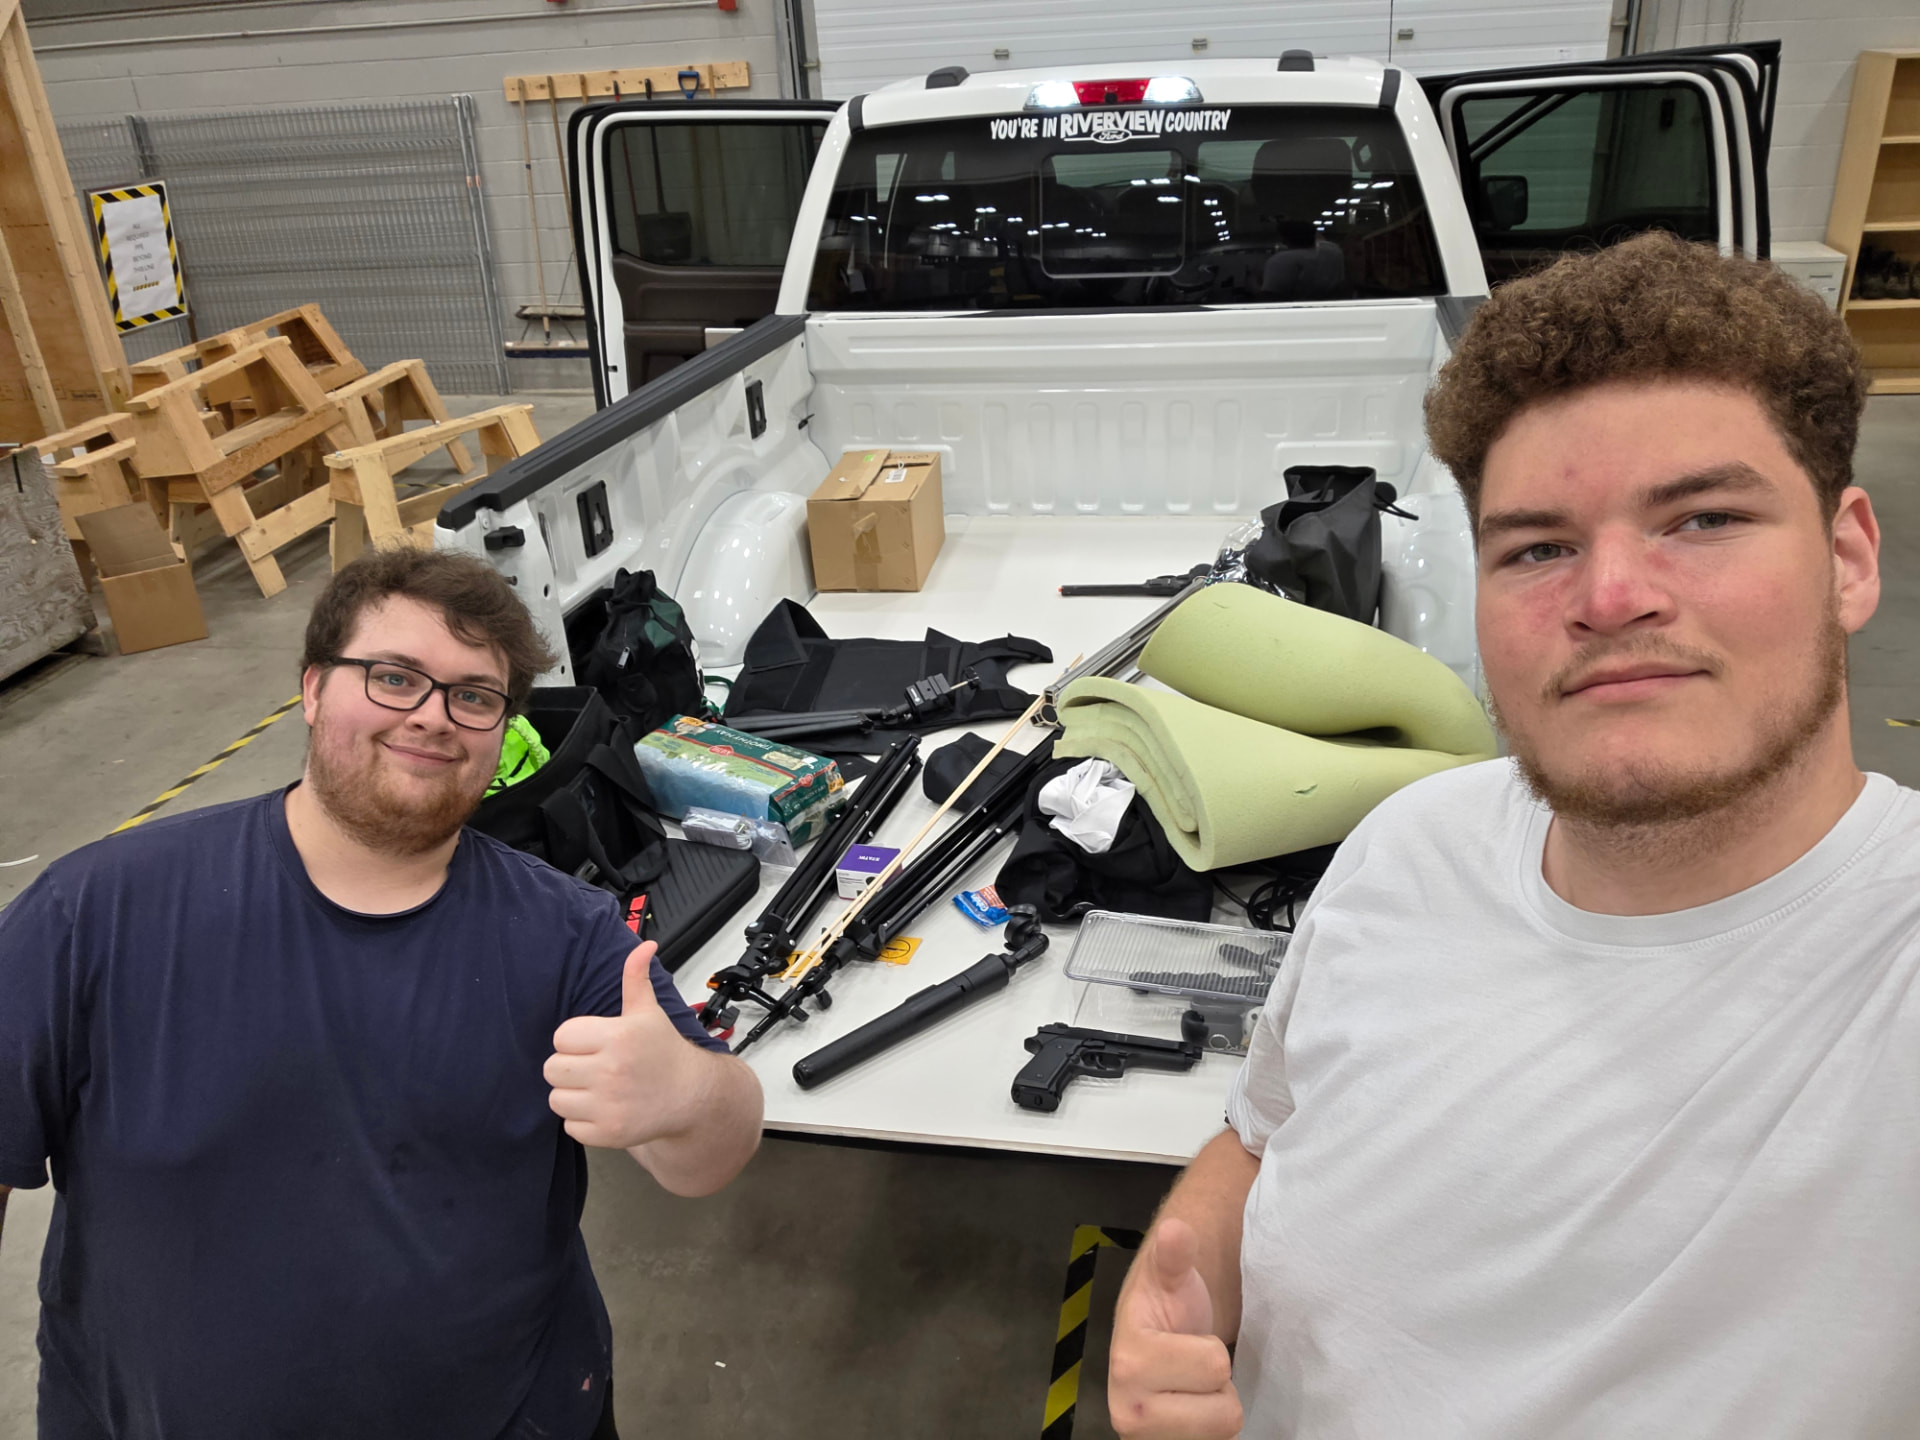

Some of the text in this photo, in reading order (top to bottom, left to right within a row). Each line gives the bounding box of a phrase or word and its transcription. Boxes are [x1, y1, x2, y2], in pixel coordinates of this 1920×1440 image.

[990, 109, 1230, 139] YOU'RE IN RIVERVIEW COUNTRY
[1098, 130, 1125, 141] Ford
